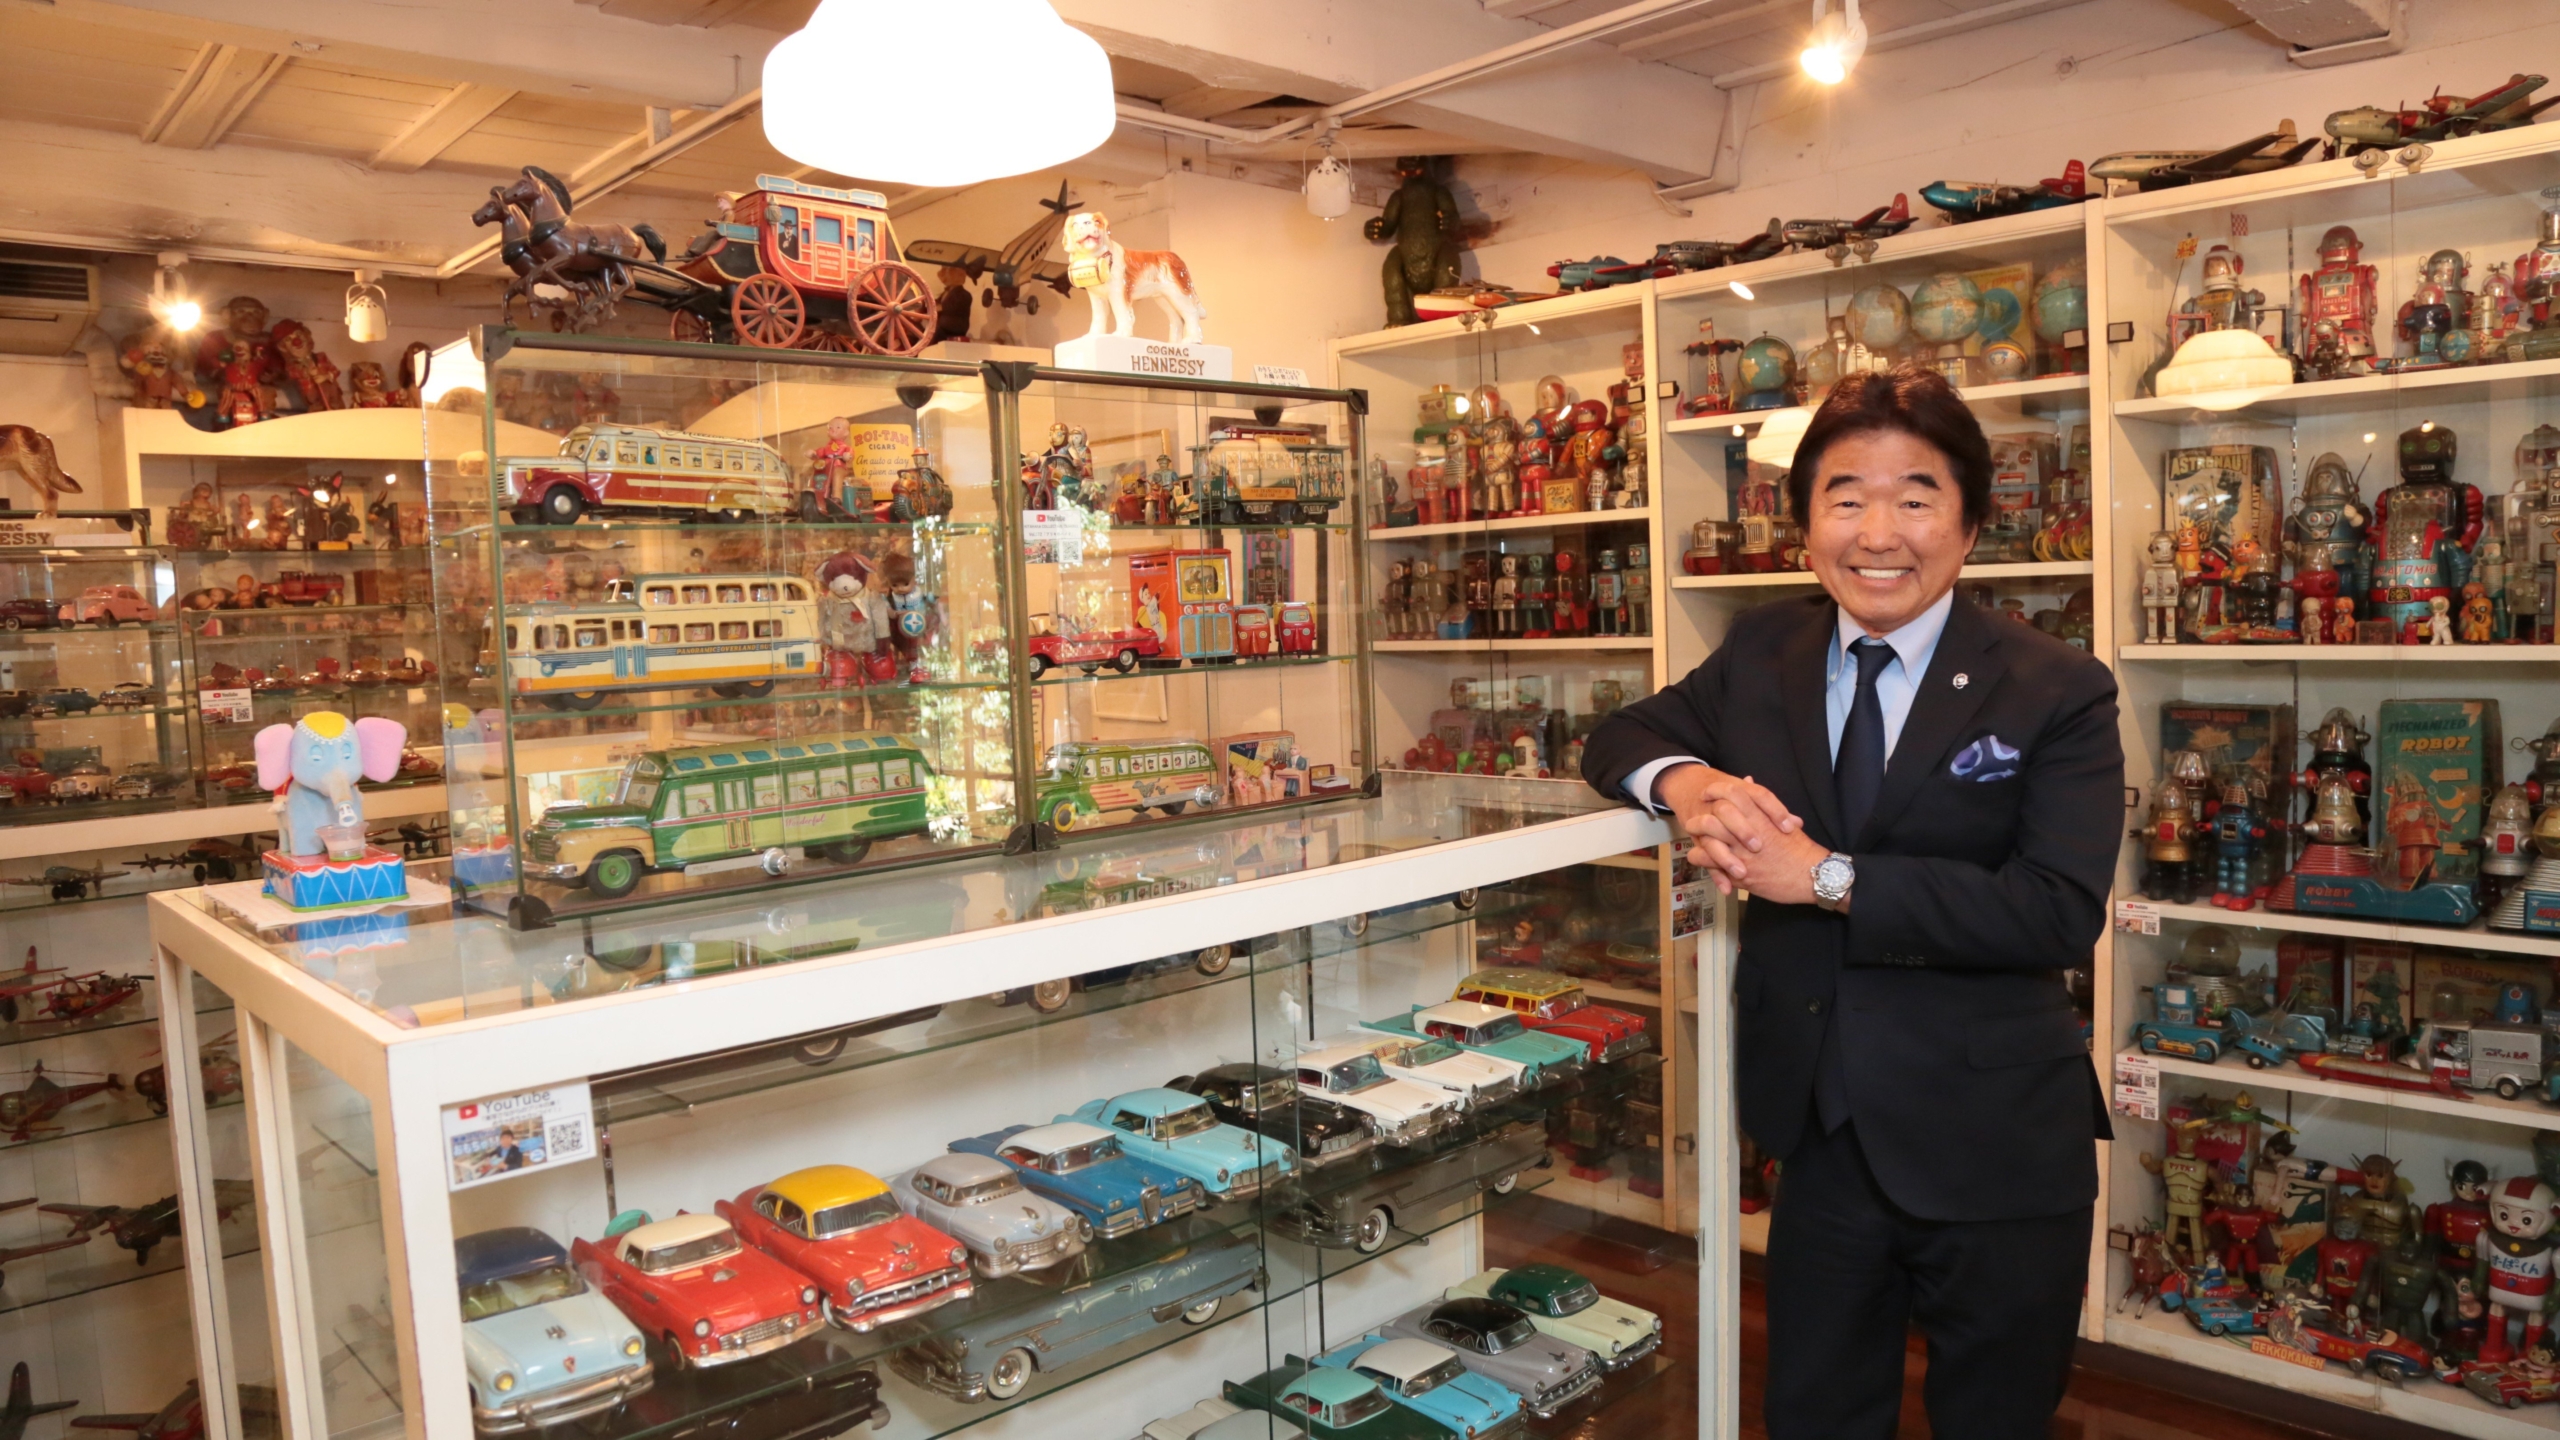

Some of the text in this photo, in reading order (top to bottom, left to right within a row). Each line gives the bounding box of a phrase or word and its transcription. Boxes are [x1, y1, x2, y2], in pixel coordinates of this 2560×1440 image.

[1146, 345, 1190, 357] COGNAC
[1131, 355, 1205, 376] HENNESSY
[854, 430, 909, 447] ROI-TAN
[856, 455, 868, 465] An
[870, 457, 886, 465] auto
[894, 456, 909, 468] day
[2171, 454, 2250, 477] ASTRONAUT
[868, 470, 887, 480] given
[1046, 514, 1066, 522] YouTube
[676, 646, 717, 655] PANORAMIC
[2388, 718, 2467, 732] MECHANIZED
[2399, 736, 2472, 752] ROBOT
[1683, 889, 1704, 900] YouTube
[2305, 886, 2353, 898] ROBBY
[481, 1090, 551, 1114] YouTube
[2251, 1341, 2324, 1370] GEKKOKAMEN
